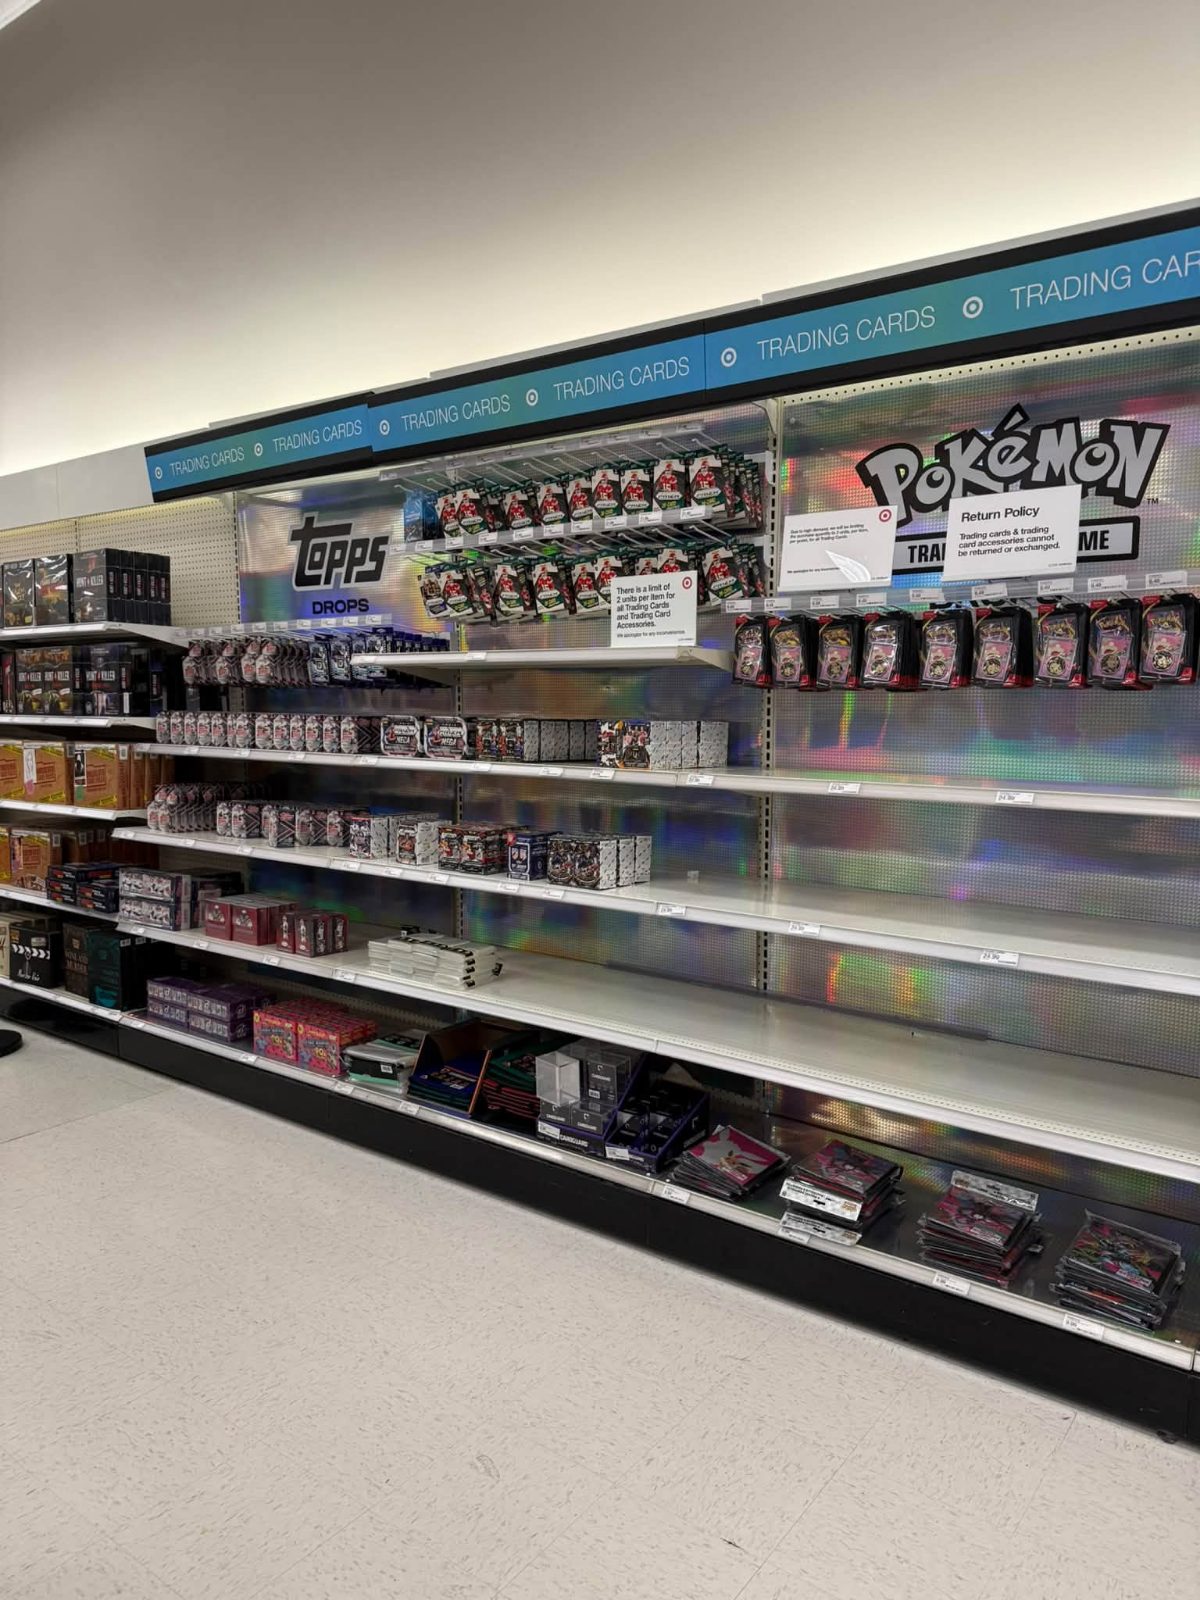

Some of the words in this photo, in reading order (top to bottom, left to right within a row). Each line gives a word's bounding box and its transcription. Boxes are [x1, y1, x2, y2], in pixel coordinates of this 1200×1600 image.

[1010, 265, 1131, 310] TRADING
[757, 324, 848, 360] TRADING
[857, 305, 935, 341] CARDS
[554, 374, 624, 401] TRADING
[630, 357, 689, 386] CARDS
[401, 405, 458, 431] TRADING
[462, 394, 510, 420] CARDS
[272, 433, 320, 453] TRADING
[323, 420, 363, 442] CARDS
[169, 454, 210, 476] TRADING
[212, 447, 245, 466] CARDS
[961, 511, 1000, 522] Return
[1004, 506, 1040, 518] Policy
[959, 540, 976, 548] card
[978, 537, 1024, 546] accessories
[1026, 534, 1054, 542] cannot
[960, 532, 987, 540] Trading
[989, 529, 1011, 538] cards
[1020, 526, 1049, 534] trading
[969, 547, 1002, 556] returned
[1014, 542, 1060, 552] exchanged.
[648, 584, 662, 592] limit
[312, 598, 369, 614] DROPS
[616, 604, 624, 612] all
[626, 603, 648, 611] Trading
[650, 601, 670, 609] Cards
[630, 612, 654, 620] Trading
[654, 609, 671, 618] Card
[616, 621, 656, 629] Accessories.
